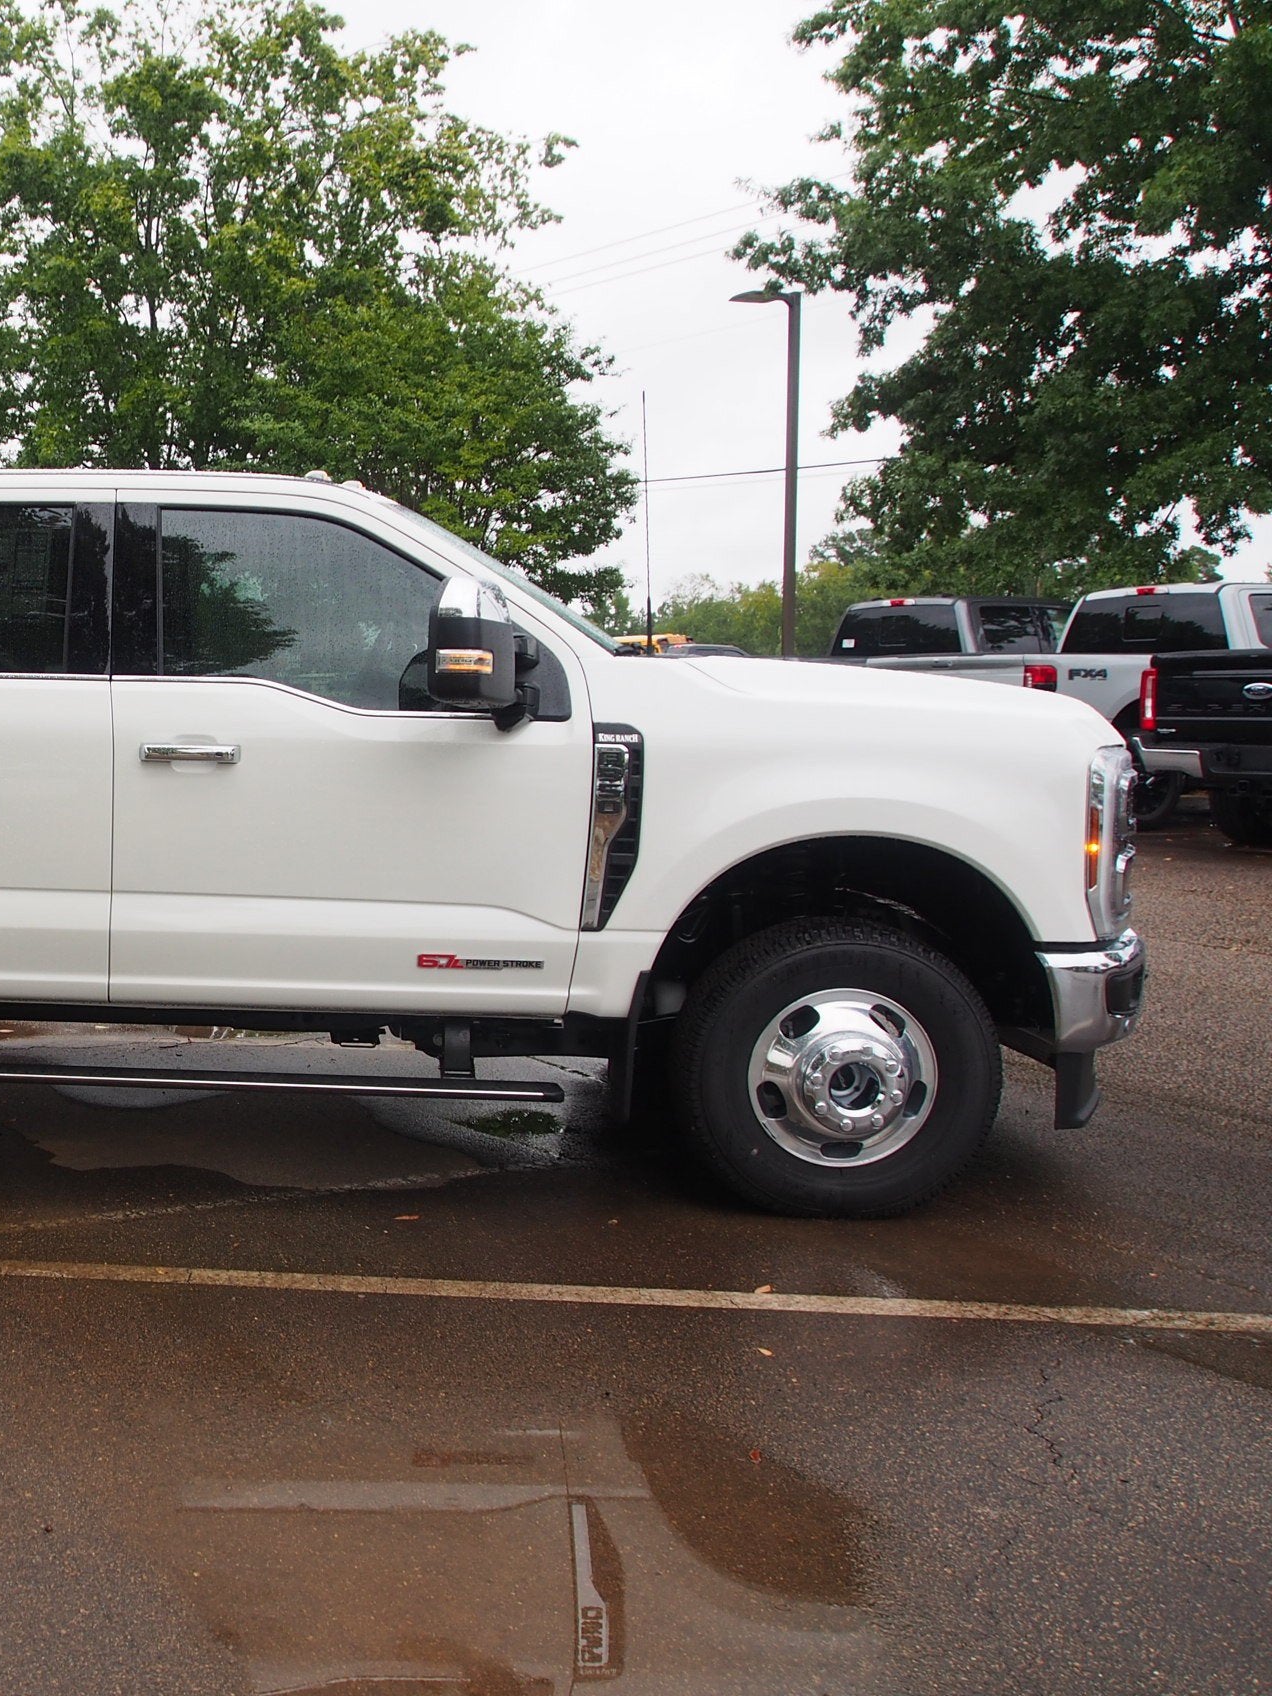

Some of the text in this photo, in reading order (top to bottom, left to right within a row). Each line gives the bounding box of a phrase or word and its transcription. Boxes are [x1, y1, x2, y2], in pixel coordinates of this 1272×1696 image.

[1068, 668, 1107, 680] FX4
[598, 733, 638, 742] KING RANCH
